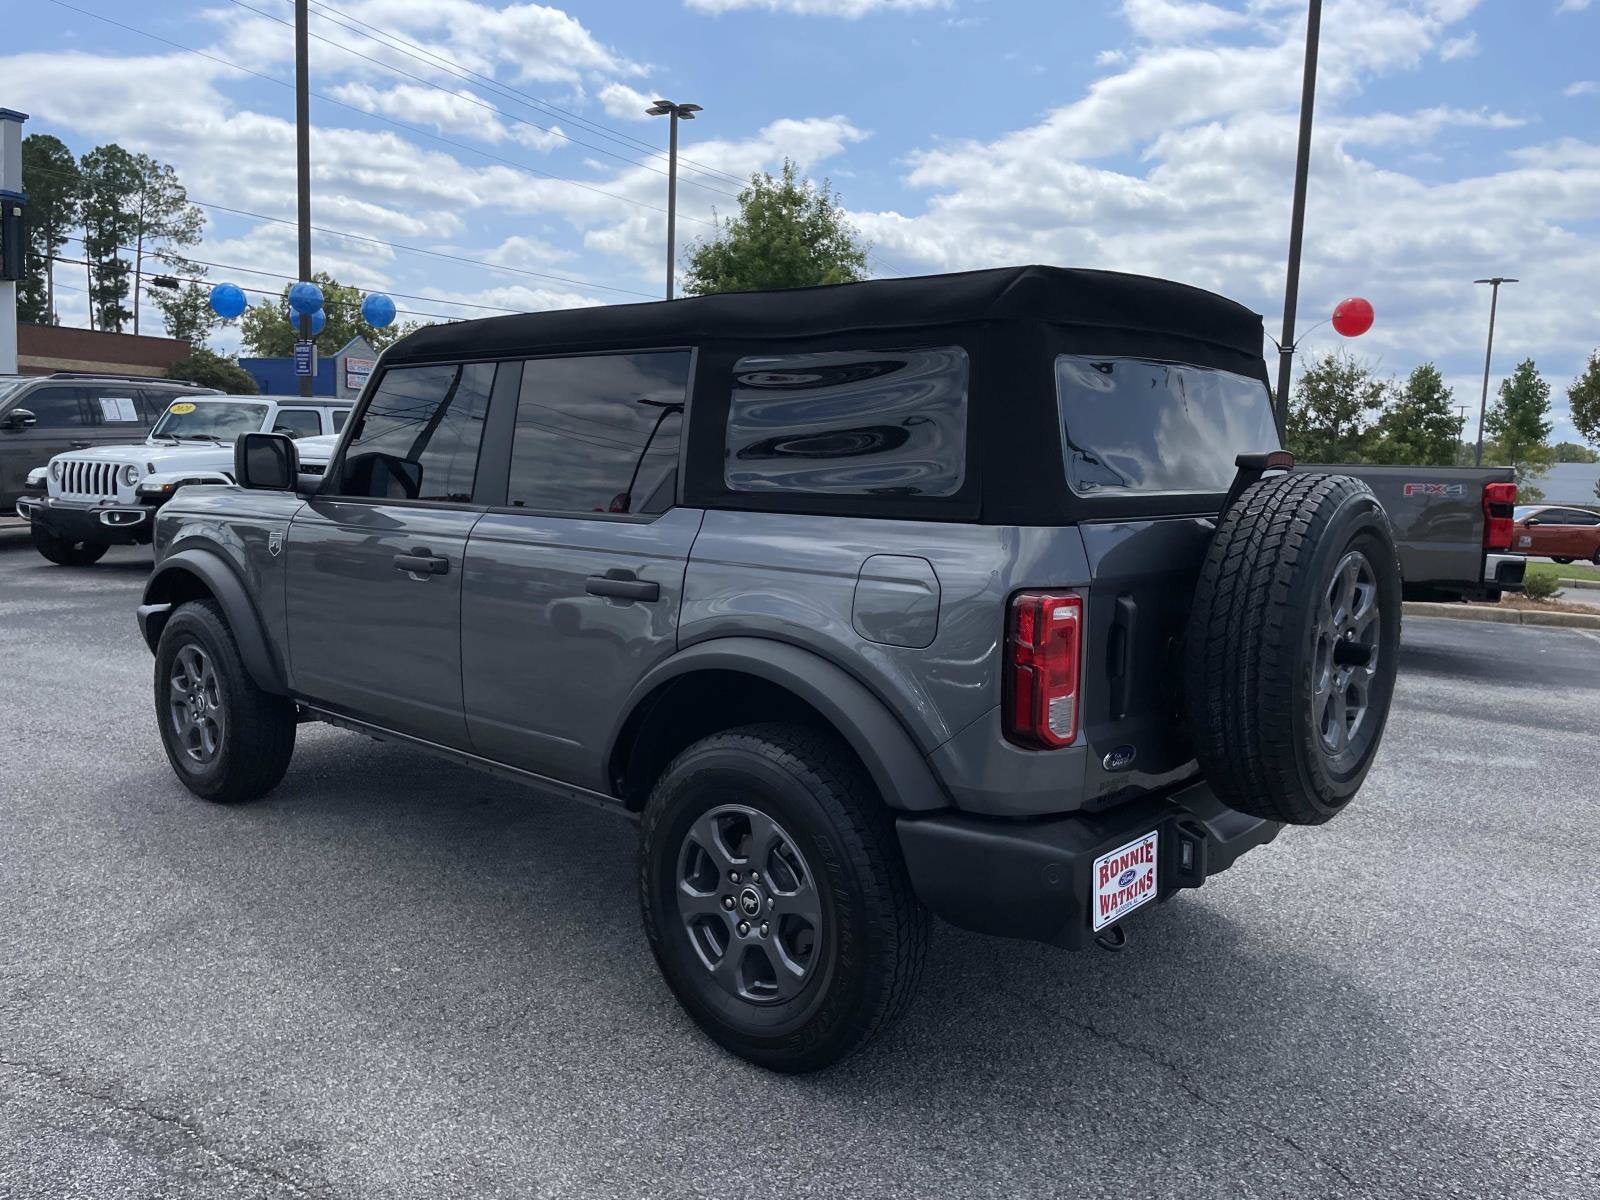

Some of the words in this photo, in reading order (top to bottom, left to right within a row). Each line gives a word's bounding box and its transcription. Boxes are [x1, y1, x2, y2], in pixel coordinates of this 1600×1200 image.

[1404, 483, 1464, 496] FX4
[1099, 842, 1154, 890] RONNIE
[1099, 868, 1154, 917] WATKINS
